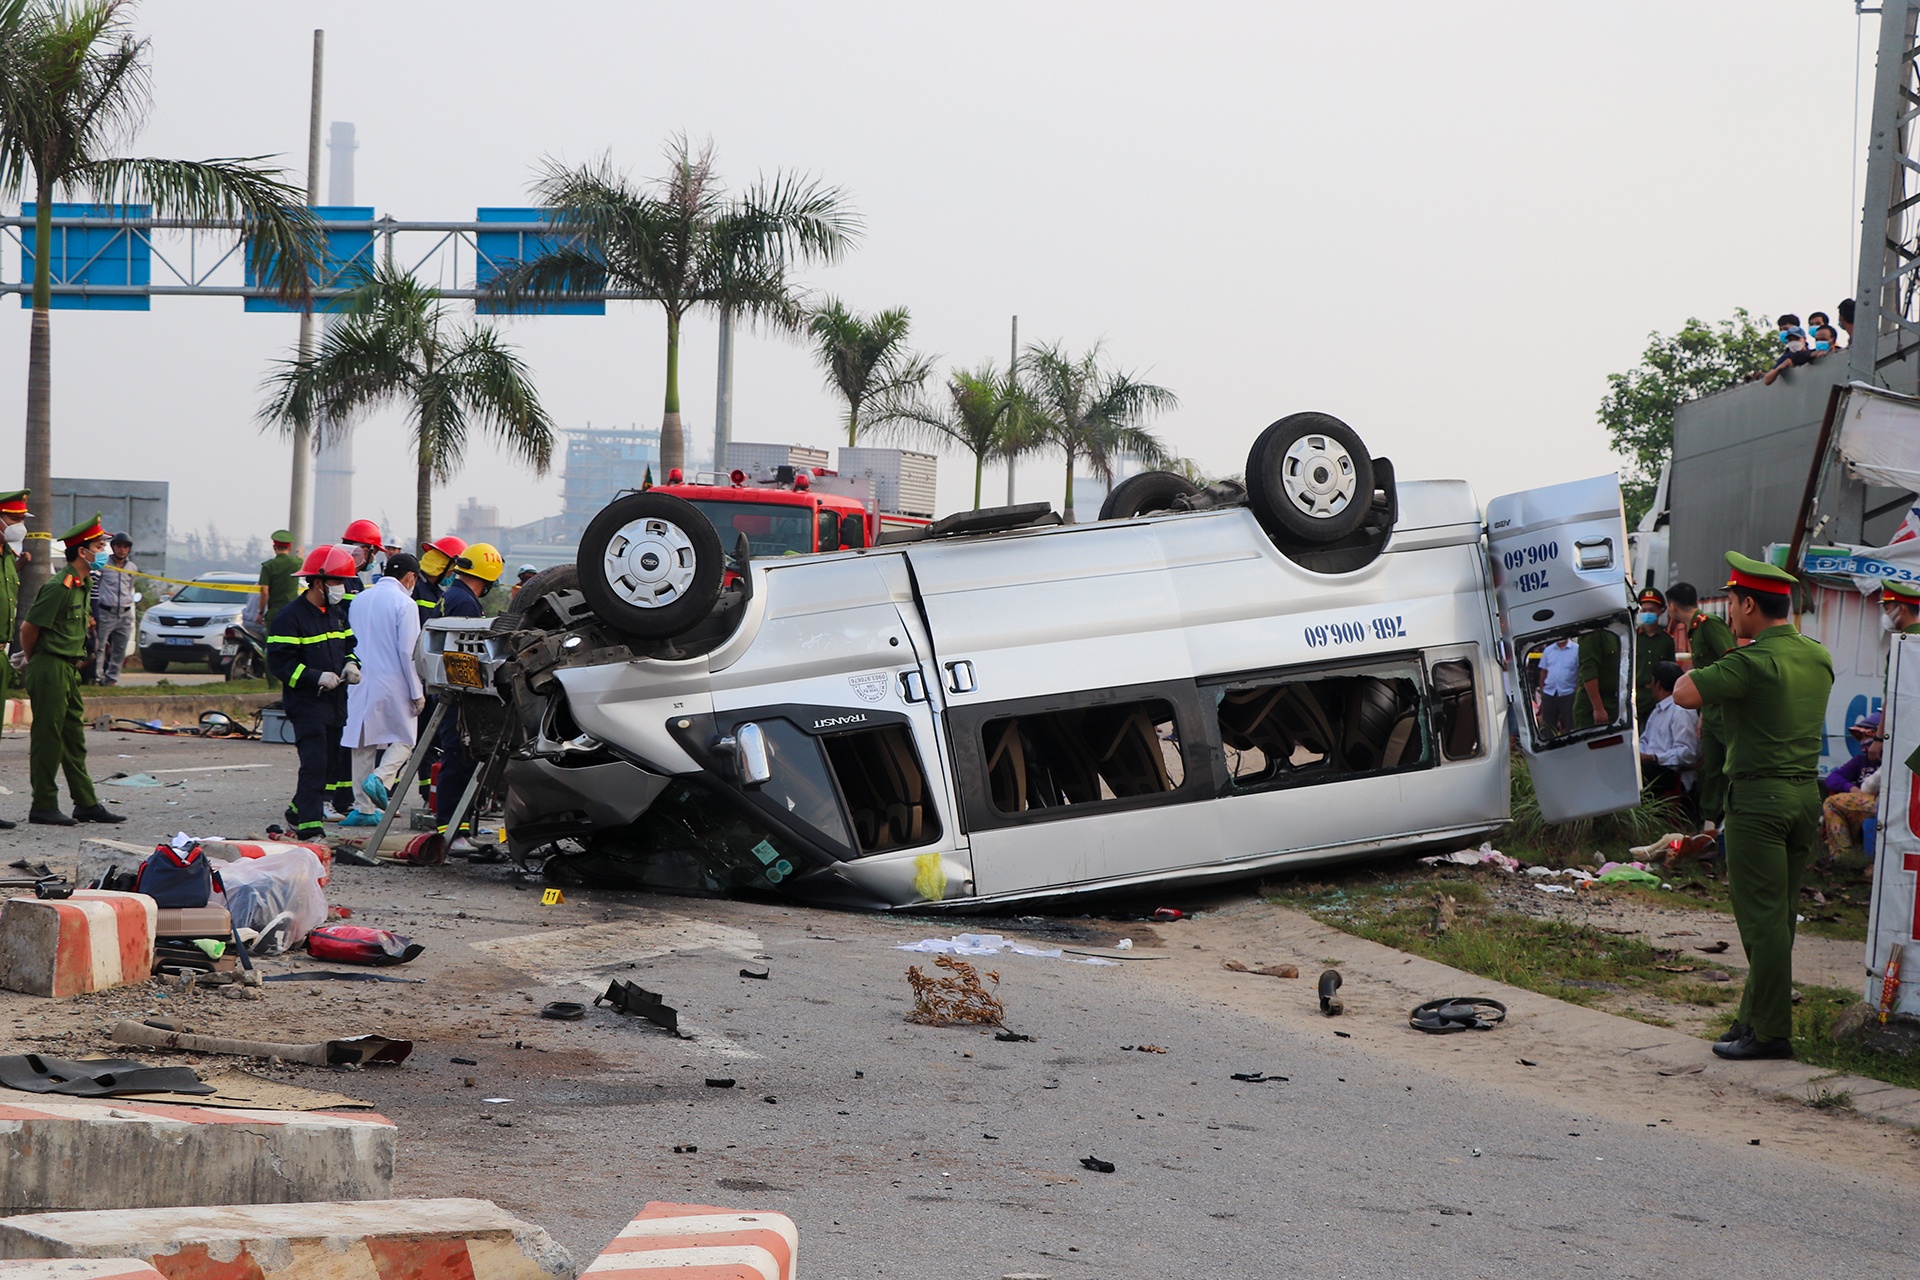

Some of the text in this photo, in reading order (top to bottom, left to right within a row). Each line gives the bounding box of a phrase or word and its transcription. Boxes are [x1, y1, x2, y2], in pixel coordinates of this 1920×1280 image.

[1503, 541, 1559, 570] 006.60
[1519, 570, 1550, 593] 76B
[1304, 615, 1407, 648] 76B 006.60
[813, 713, 868, 729] TRANSIT
[546, 891, 556, 901] 11
